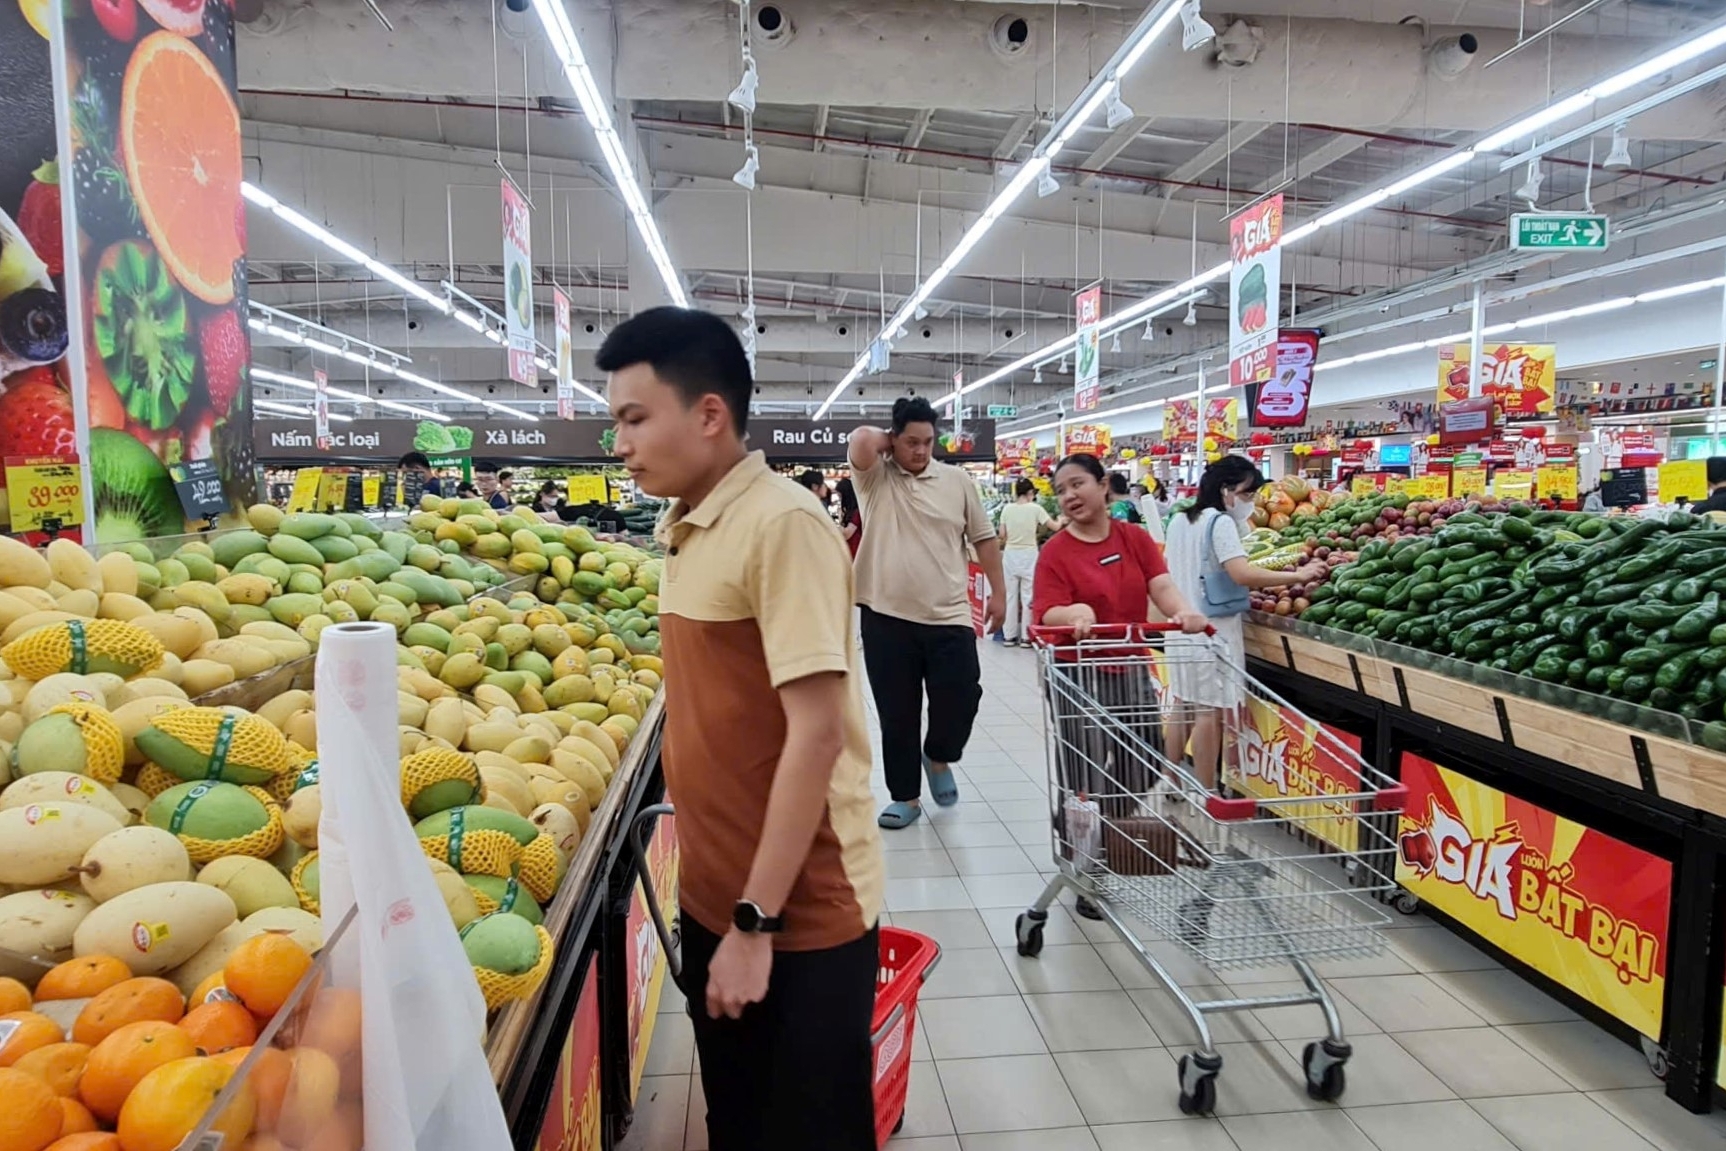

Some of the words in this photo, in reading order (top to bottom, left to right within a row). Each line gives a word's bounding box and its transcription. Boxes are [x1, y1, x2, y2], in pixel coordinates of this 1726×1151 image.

[1530, 233, 1554, 244] EXIT
[271, 429, 312, 447] Nấm
[349, 431, 379, 450] loại
[485, 429, 508, 445] Xà
[511, 429, 546, 445] lách
[773, 429, 805, 444] Rau
[810, 426, 833, 444] Củ
[1287, 748, 1322, 797] BẤT
[1430, 797, 1523, 920] GIÁ
[1520, 851, 1544, 871] LUÔN
[1518, 862, 1584, 938] BẤT
[1588, 906, 1657, 984] BẠI
